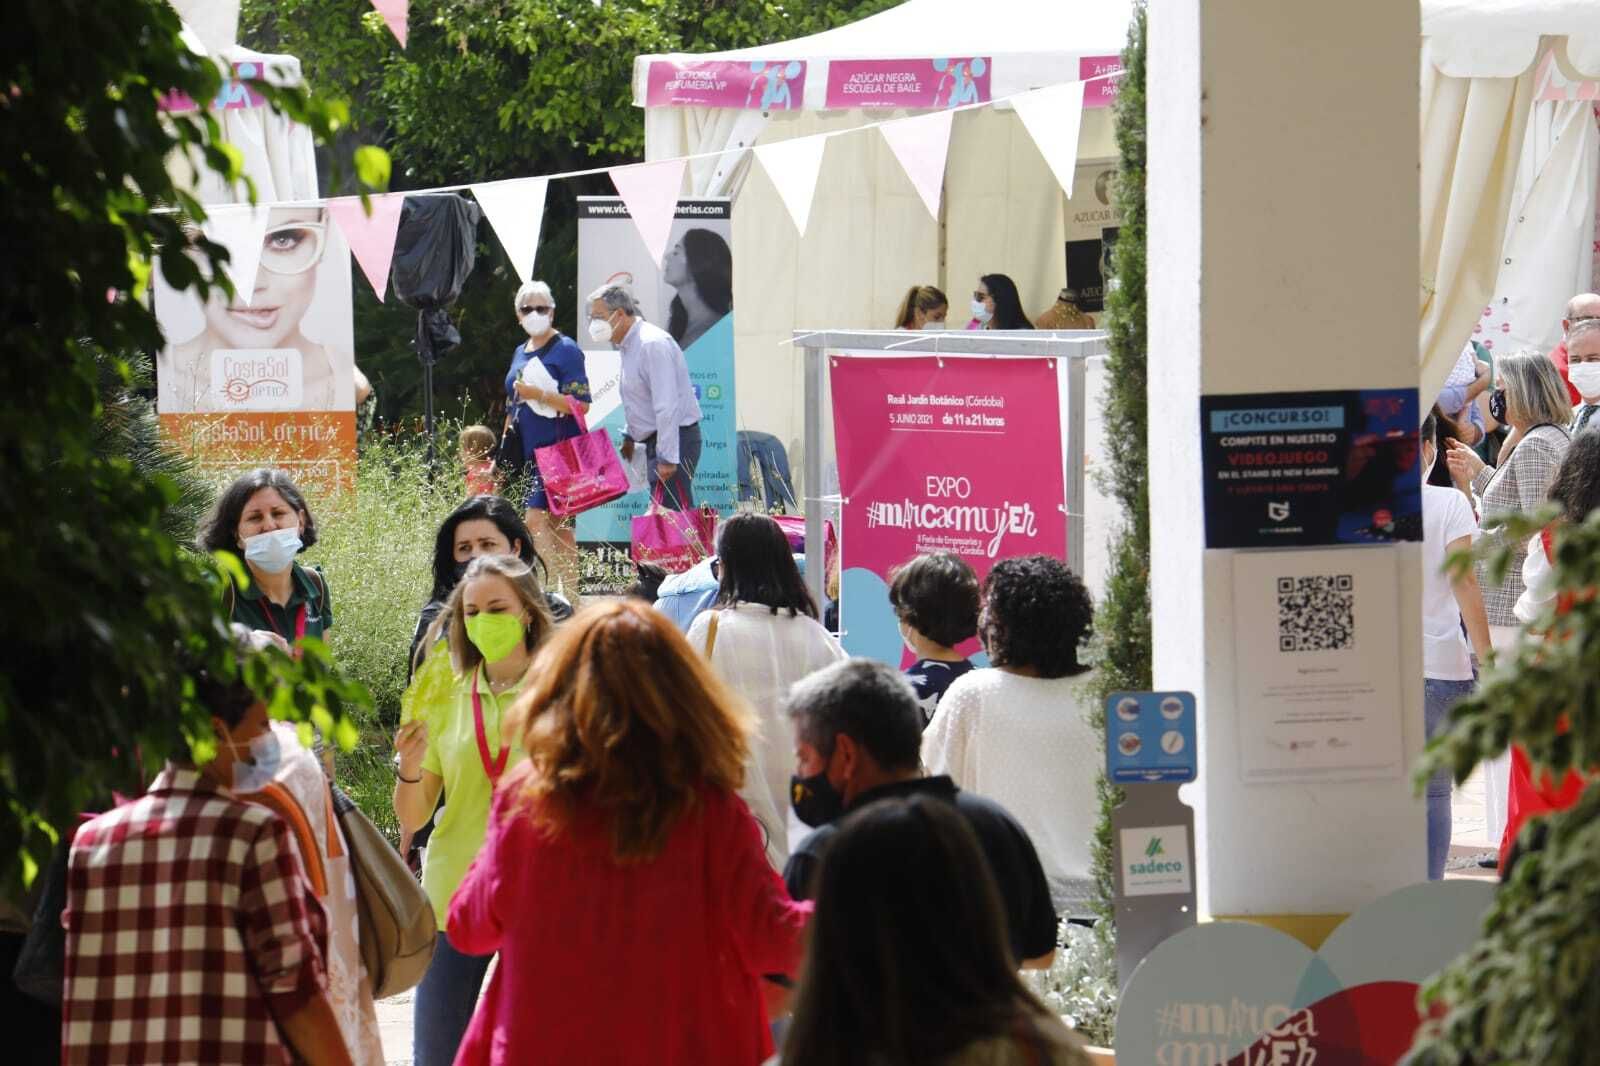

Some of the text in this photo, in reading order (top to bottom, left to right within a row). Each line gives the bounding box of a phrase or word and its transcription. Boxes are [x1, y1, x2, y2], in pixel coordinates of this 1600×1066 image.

[849, 72, 916, 83] AZÚCAR NEGRA
[843, 83, 921, 94] ESCUELA DE BAILE
[887, 394, 905, 405] Real
[930, 394, 964, 406] Botánico
[965, 395, 1004, 408] (Córdoba)
[889, 413, 895, 423] 5
[896, 413, 916, 424] JUNIO
[917, 414, 933, 424] 2021
[942, 412, 954, 425] de
[954, 413, 964, 425] 11
[972, 413, 982, 426] 21
[983, 413, 1005, 426] horas
[1223, 410, 1329, 428] ¡CONCURSO!
[1220, 433, 1337, 447] COMPITE EN NUESTRO
[1227, 451, 1329, 465] VIDEOJUEGO
[1231, 471, 1241, 479] EL
[1242, 470, 1270, 479] STAND
[1271, 469, 1280, 478] DE
[1283, 468, 1303, 478] NEW
[1304, 466, 1340, 476] GAMING
[926, 475, 971, 499] EXPO
[1129, 858, 1183, 876] sadeco
